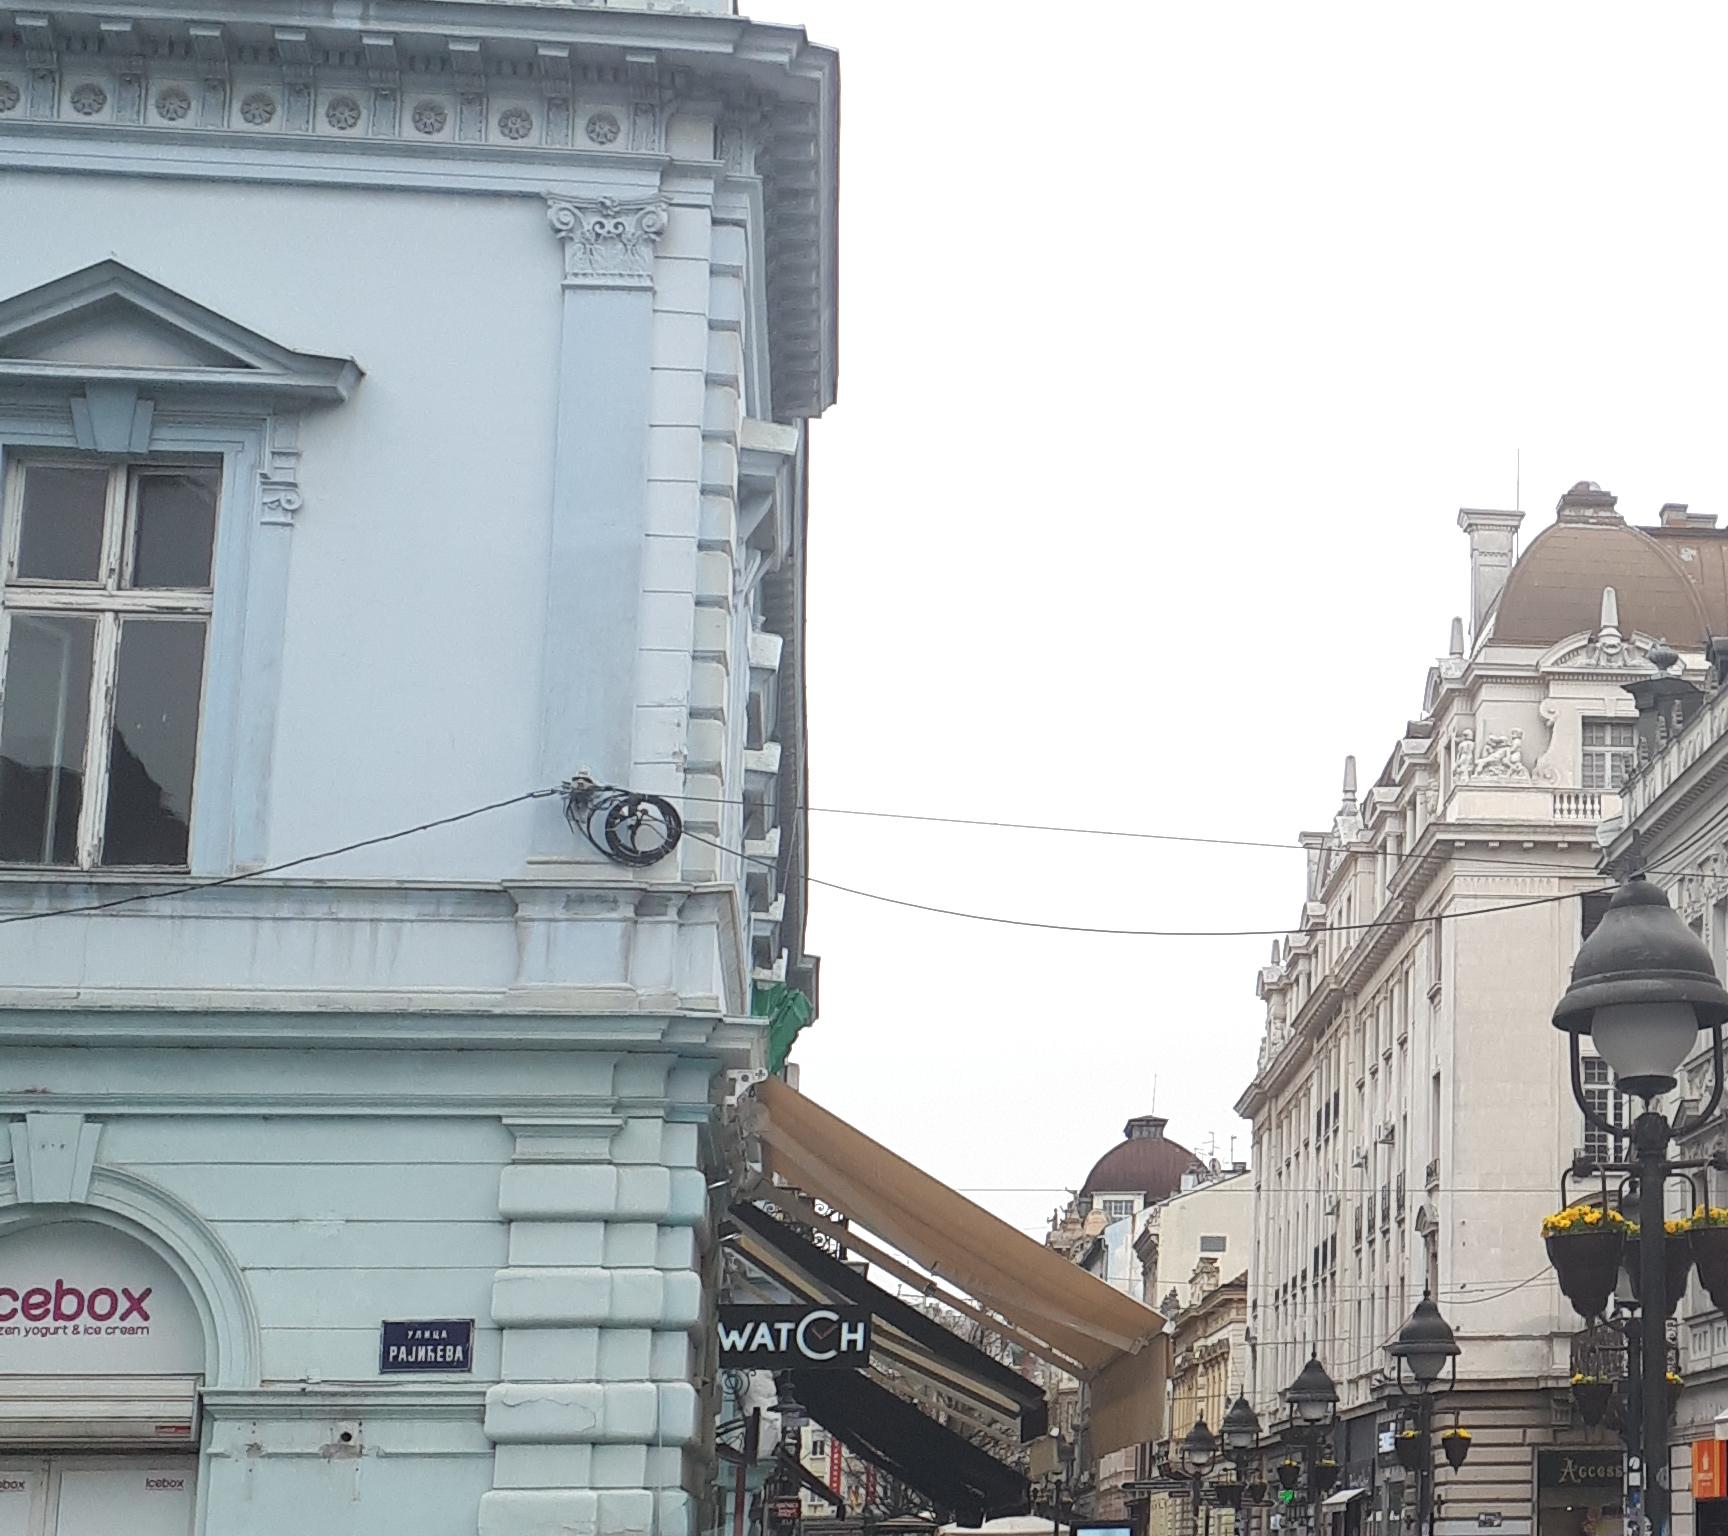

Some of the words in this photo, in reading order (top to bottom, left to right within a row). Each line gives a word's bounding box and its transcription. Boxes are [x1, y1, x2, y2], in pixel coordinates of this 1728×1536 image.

[23, 1325, 68, 1338] yogurt
[71, 1324, 81, 1336] &
[83, 1324, 101, 1335] ice
[105, 1325, 150, 1336] cream
[407, 1330, 448, 1340] УЛИЦА
[717, 1310, 865, 1360] WATCH
[389, 1346, 464, 1362] РАЈИЋЕВА
